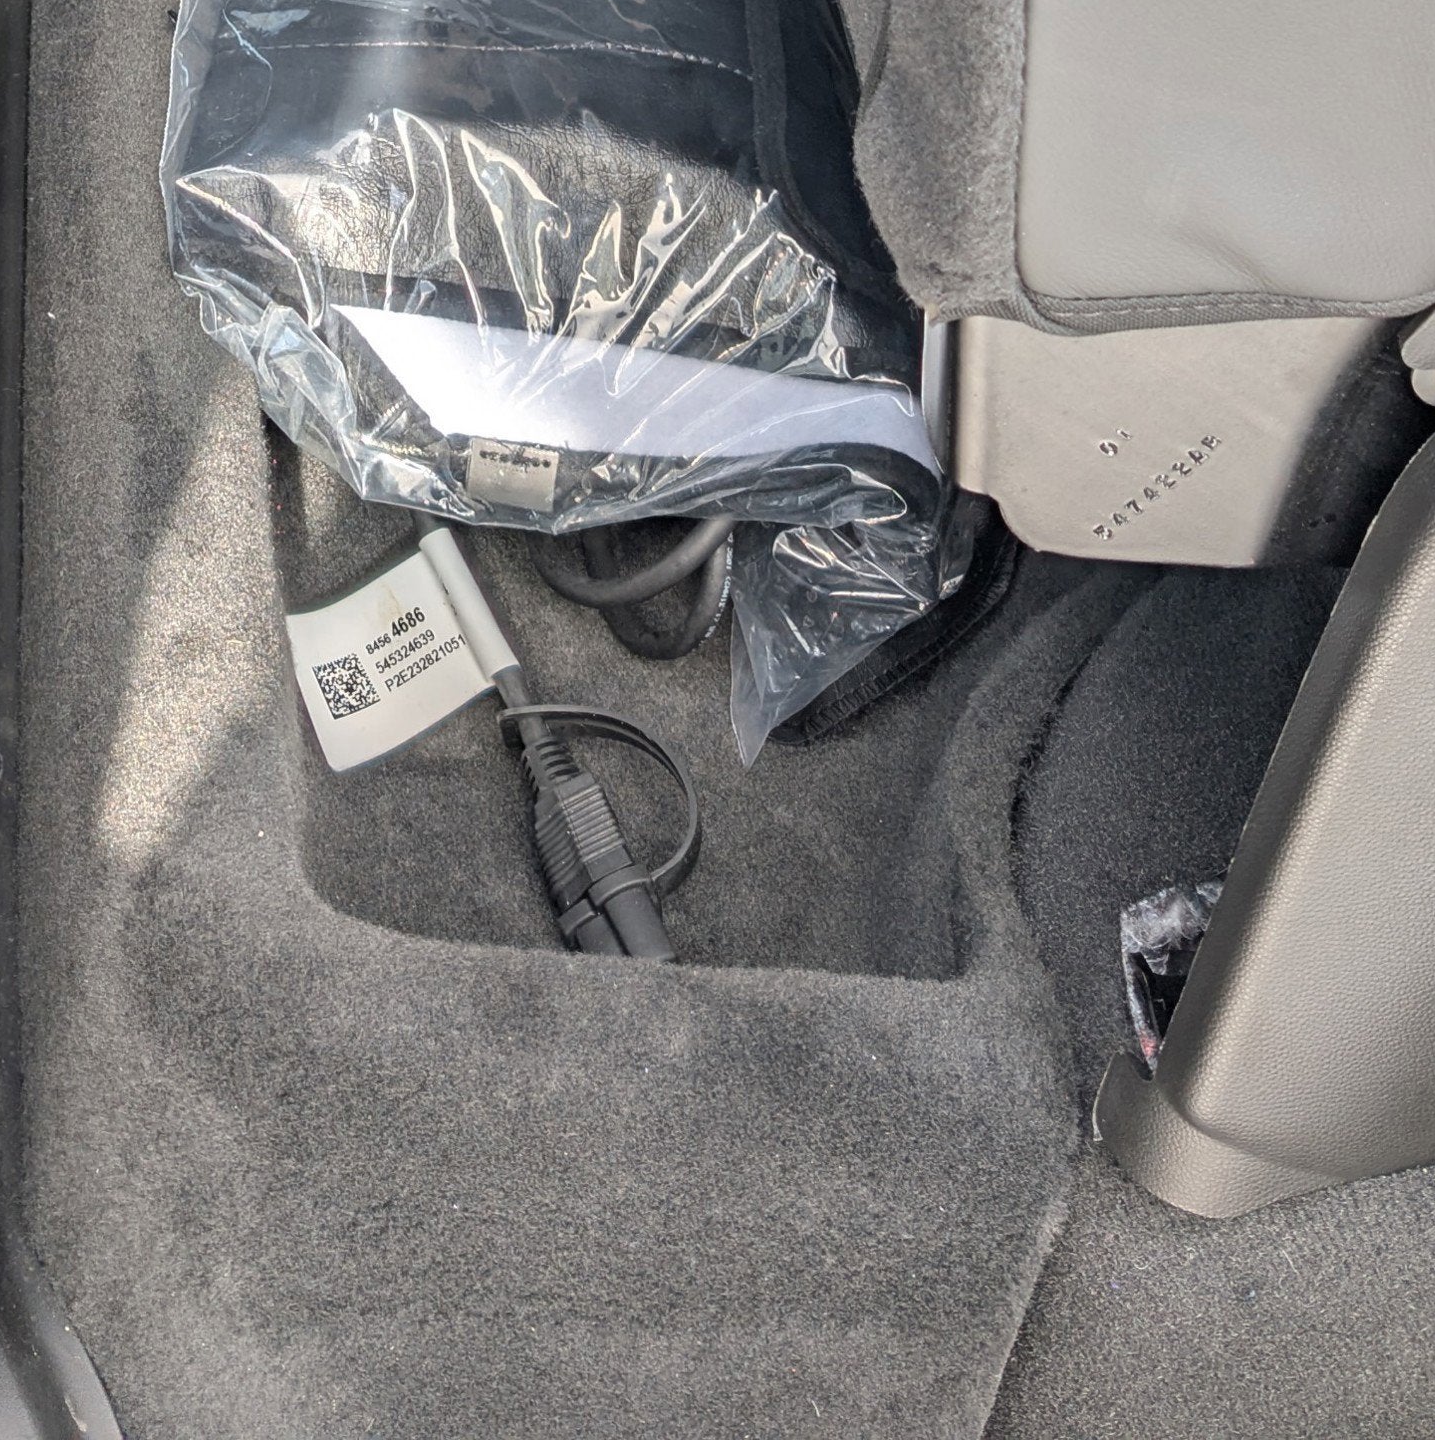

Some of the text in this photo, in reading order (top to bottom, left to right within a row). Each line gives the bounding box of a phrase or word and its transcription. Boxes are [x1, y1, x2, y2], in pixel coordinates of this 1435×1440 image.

[365, 606, 425, 655] 8456 4686
[375, 629, 436, 674] 545324639
[384, 633, 467, 692] P2E232821051
